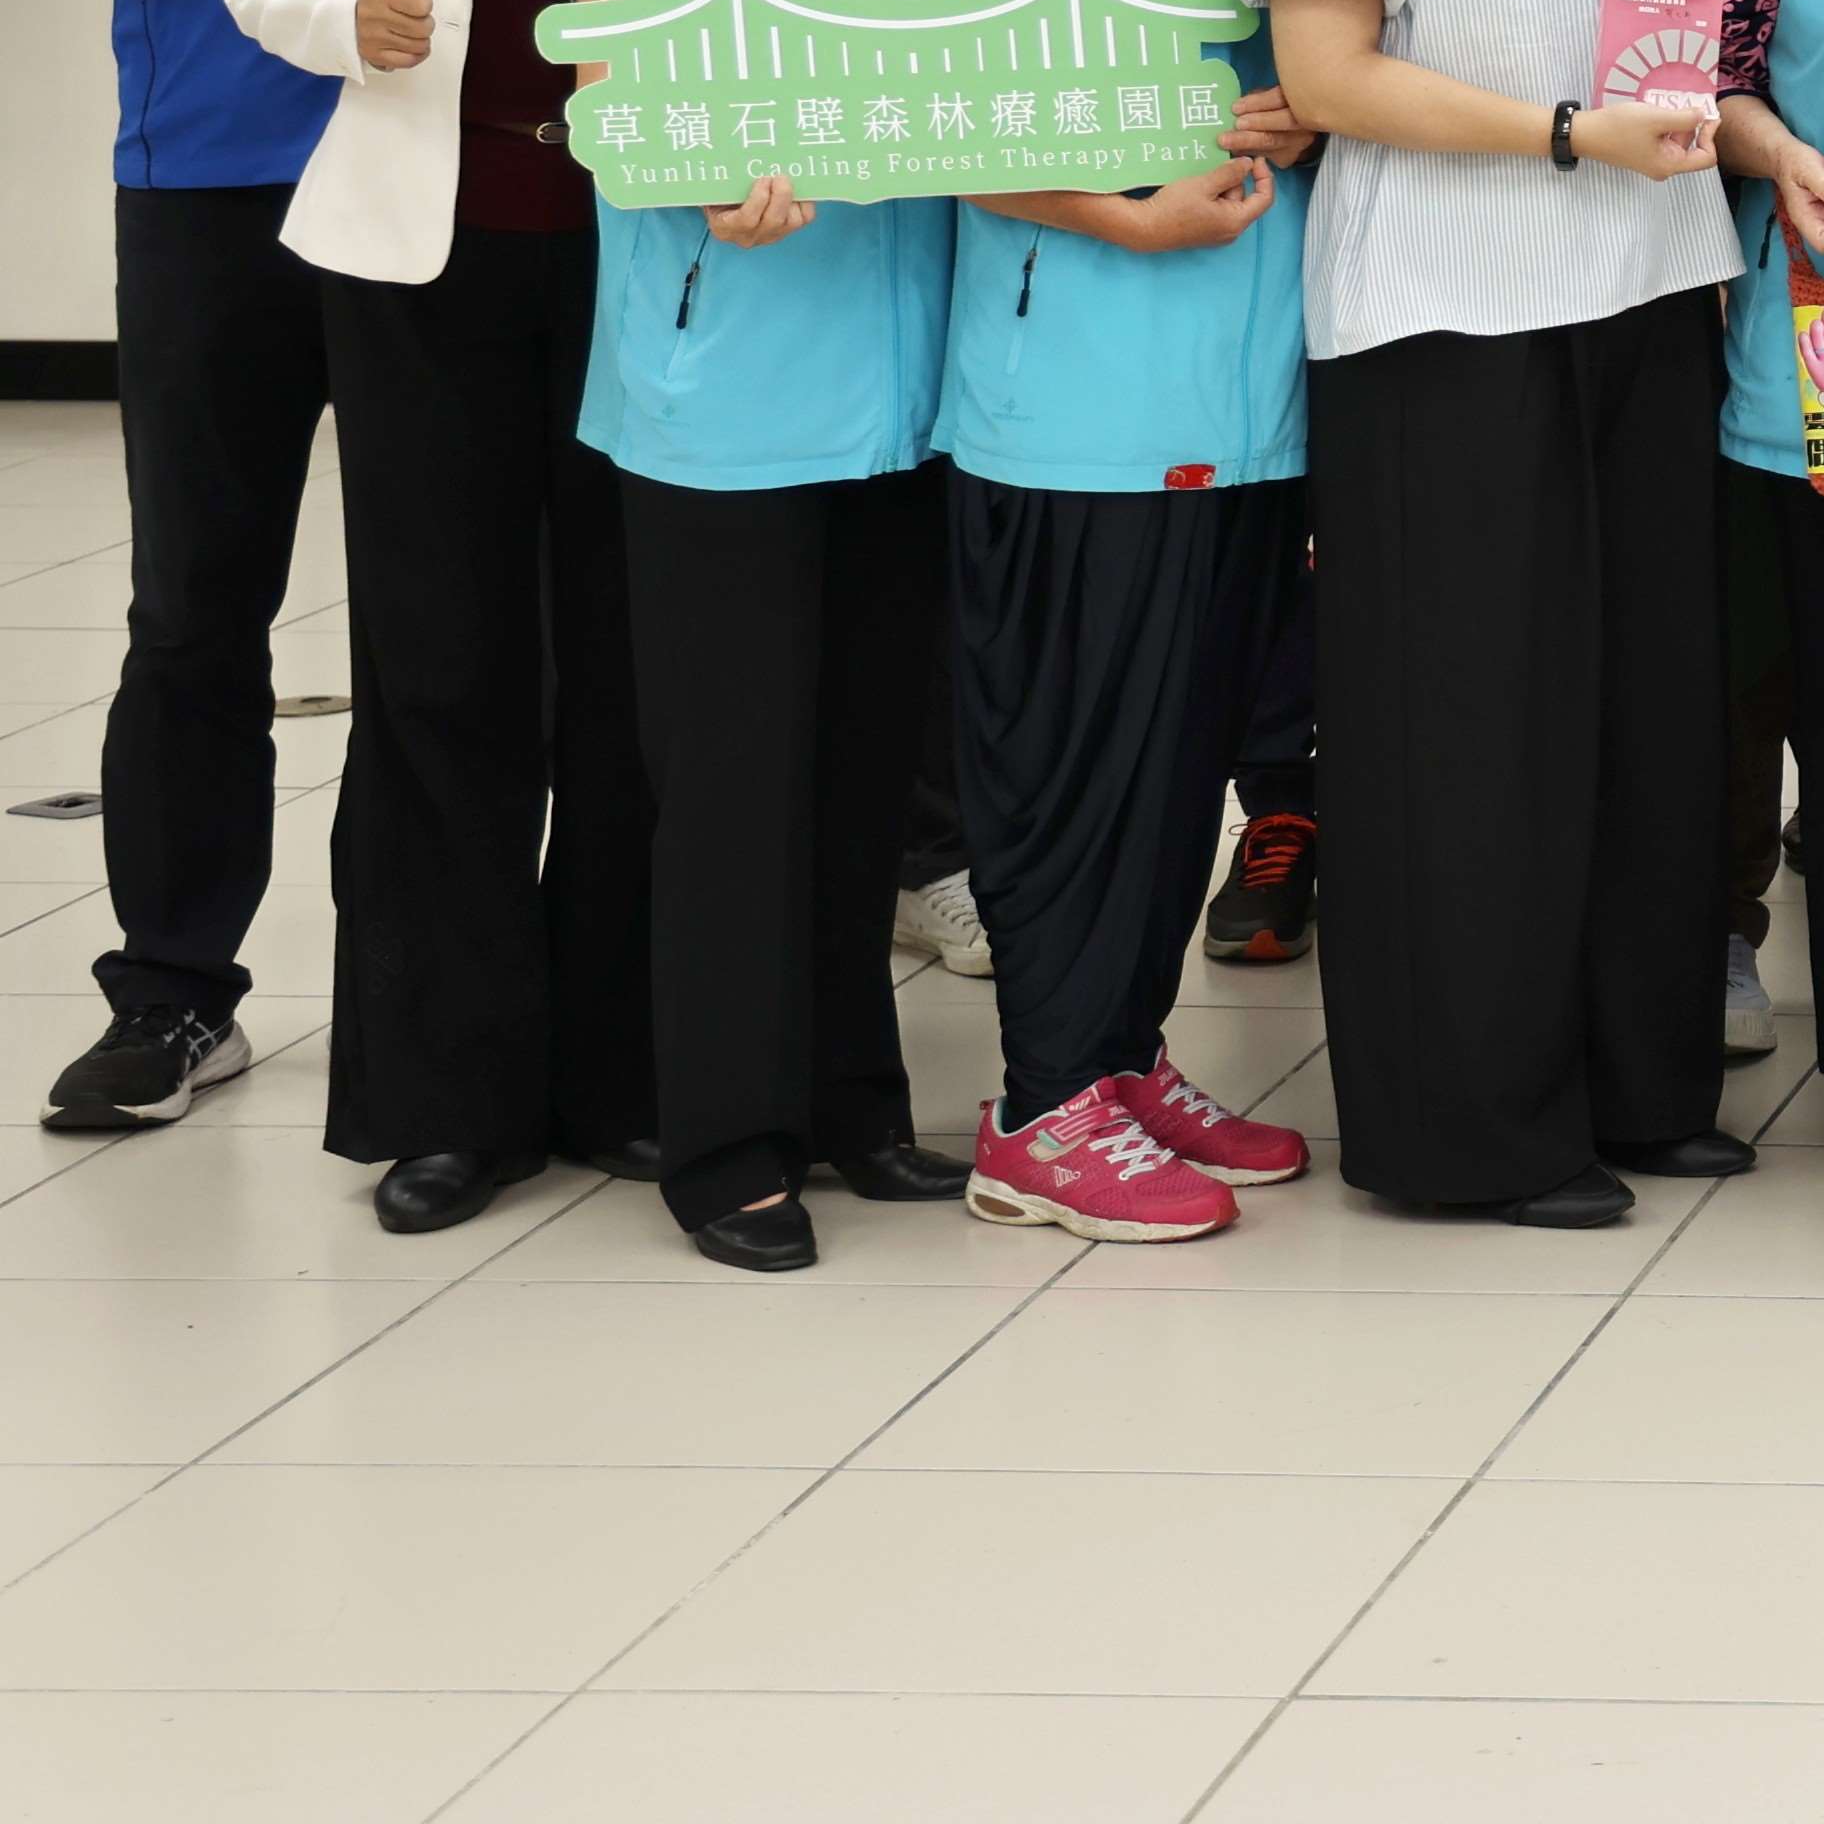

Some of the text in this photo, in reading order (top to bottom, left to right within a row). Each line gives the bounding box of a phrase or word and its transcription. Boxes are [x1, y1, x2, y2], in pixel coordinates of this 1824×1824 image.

[594, 82, 1225, 154] 草嶺石壁森林療癒園區
[621, 138, 1208, 185] Yunlin Caoling Forest Therapy Park
